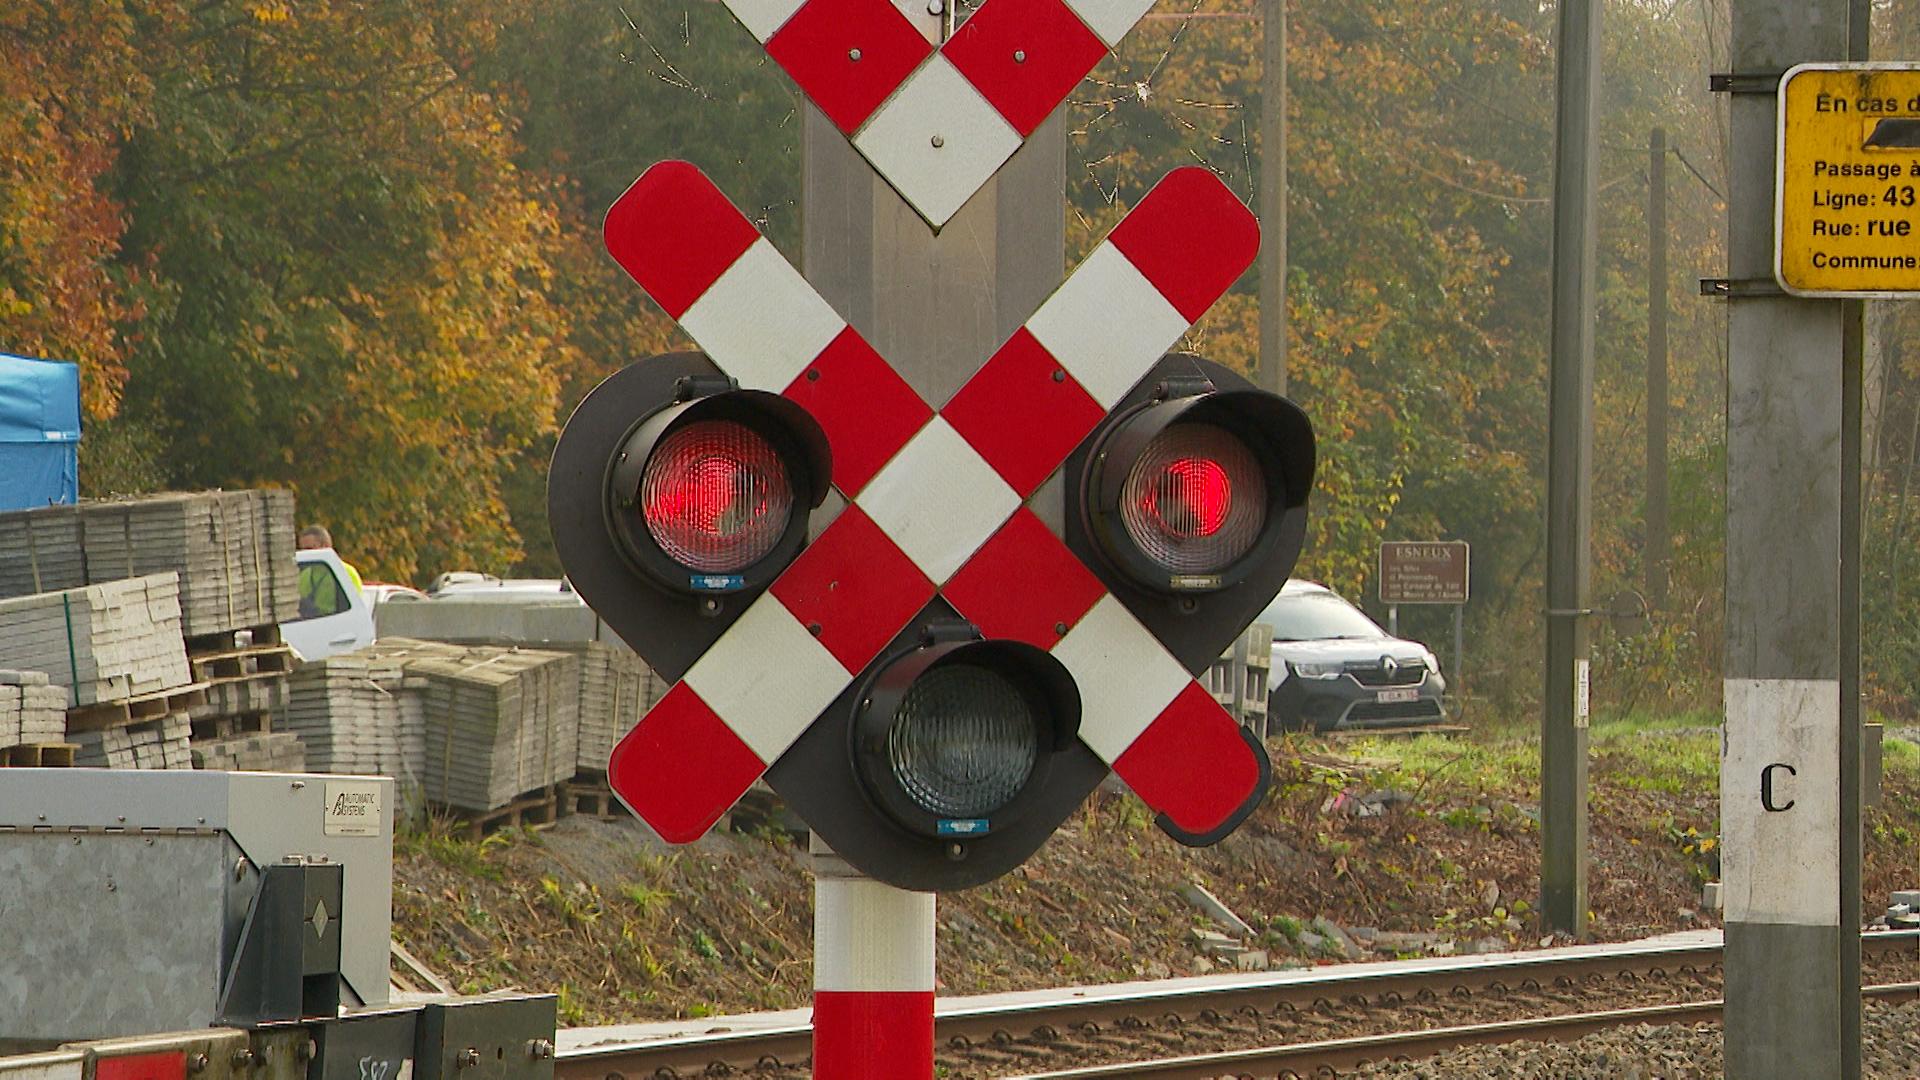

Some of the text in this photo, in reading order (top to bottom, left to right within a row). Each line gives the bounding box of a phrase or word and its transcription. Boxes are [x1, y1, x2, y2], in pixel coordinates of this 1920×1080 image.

[1816, 95, 1847, 112] En
[1856, 97, 1898, 112] cas
[1814, 161, 1901, 180] Passage
[1813, 186, 1916, 210] Ligne: 43
[1812, 220, 1911, 236] Rue: rue
[1396, 547, 1452, 558] ESNEUX
[1761, 763, 1797, 812] C
[345, 793, 375, 804] AUTOMATIC
[343, 805, 366, 816] SYSTEMS
